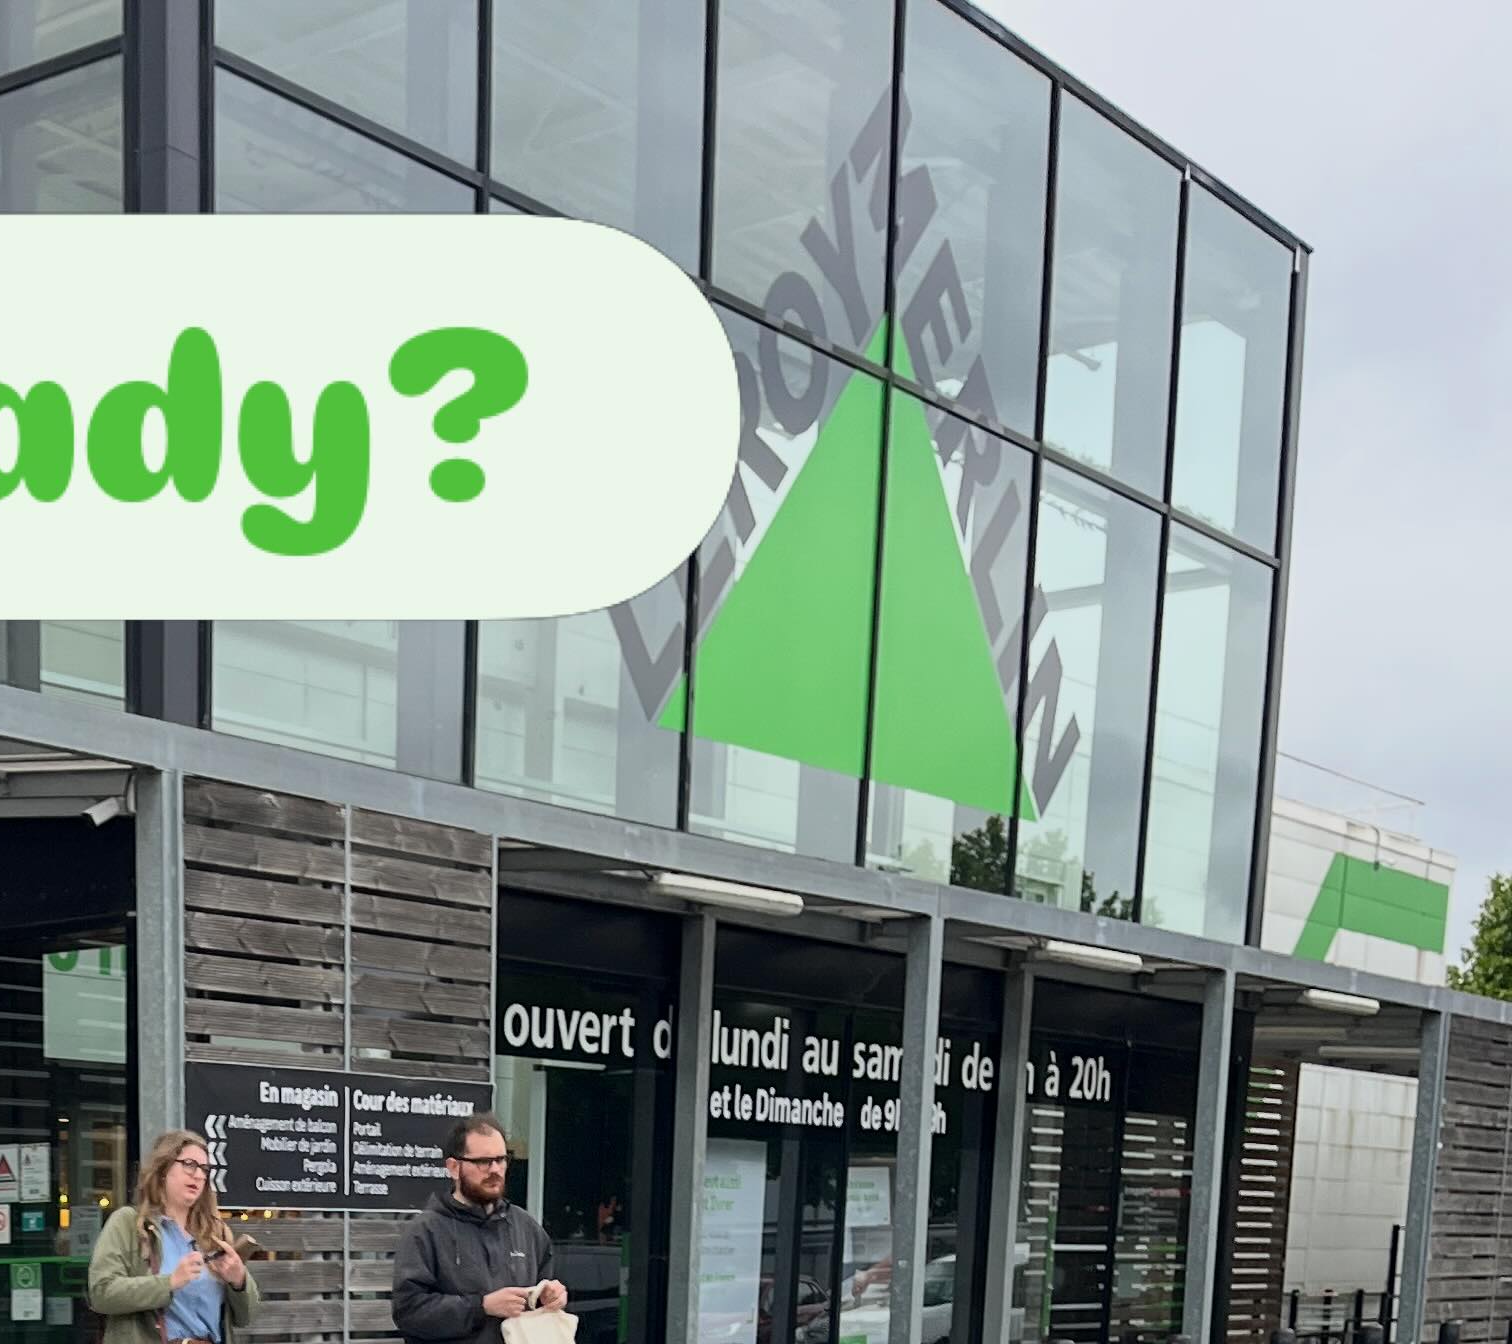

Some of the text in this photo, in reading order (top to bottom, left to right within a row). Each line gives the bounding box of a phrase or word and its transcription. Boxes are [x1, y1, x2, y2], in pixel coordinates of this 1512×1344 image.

[849, 80, 1082, 815] MERLIN
[503, 1003, 635, 1057] ouvert
[653, 1004, 673, 1059] d
[711, 1009, 790, 1070] lundi
[802, 1036, 839, 1076] au
[961, 1042, 994, 1091] de
[1045, 1050, 1060, 1097] à
[1069, 1056, 1111, 1101] 20h
[260, 1081, 338, 1110] En magasin
[353, 1089, 474, 1117] Cour des matériaux
[709, 1085, 732, 1119] et
[734, 1084, 753, 1121] le
[755, 1087, 844, 1128] Dimanche
[860, 1096, 882, 1130] de
